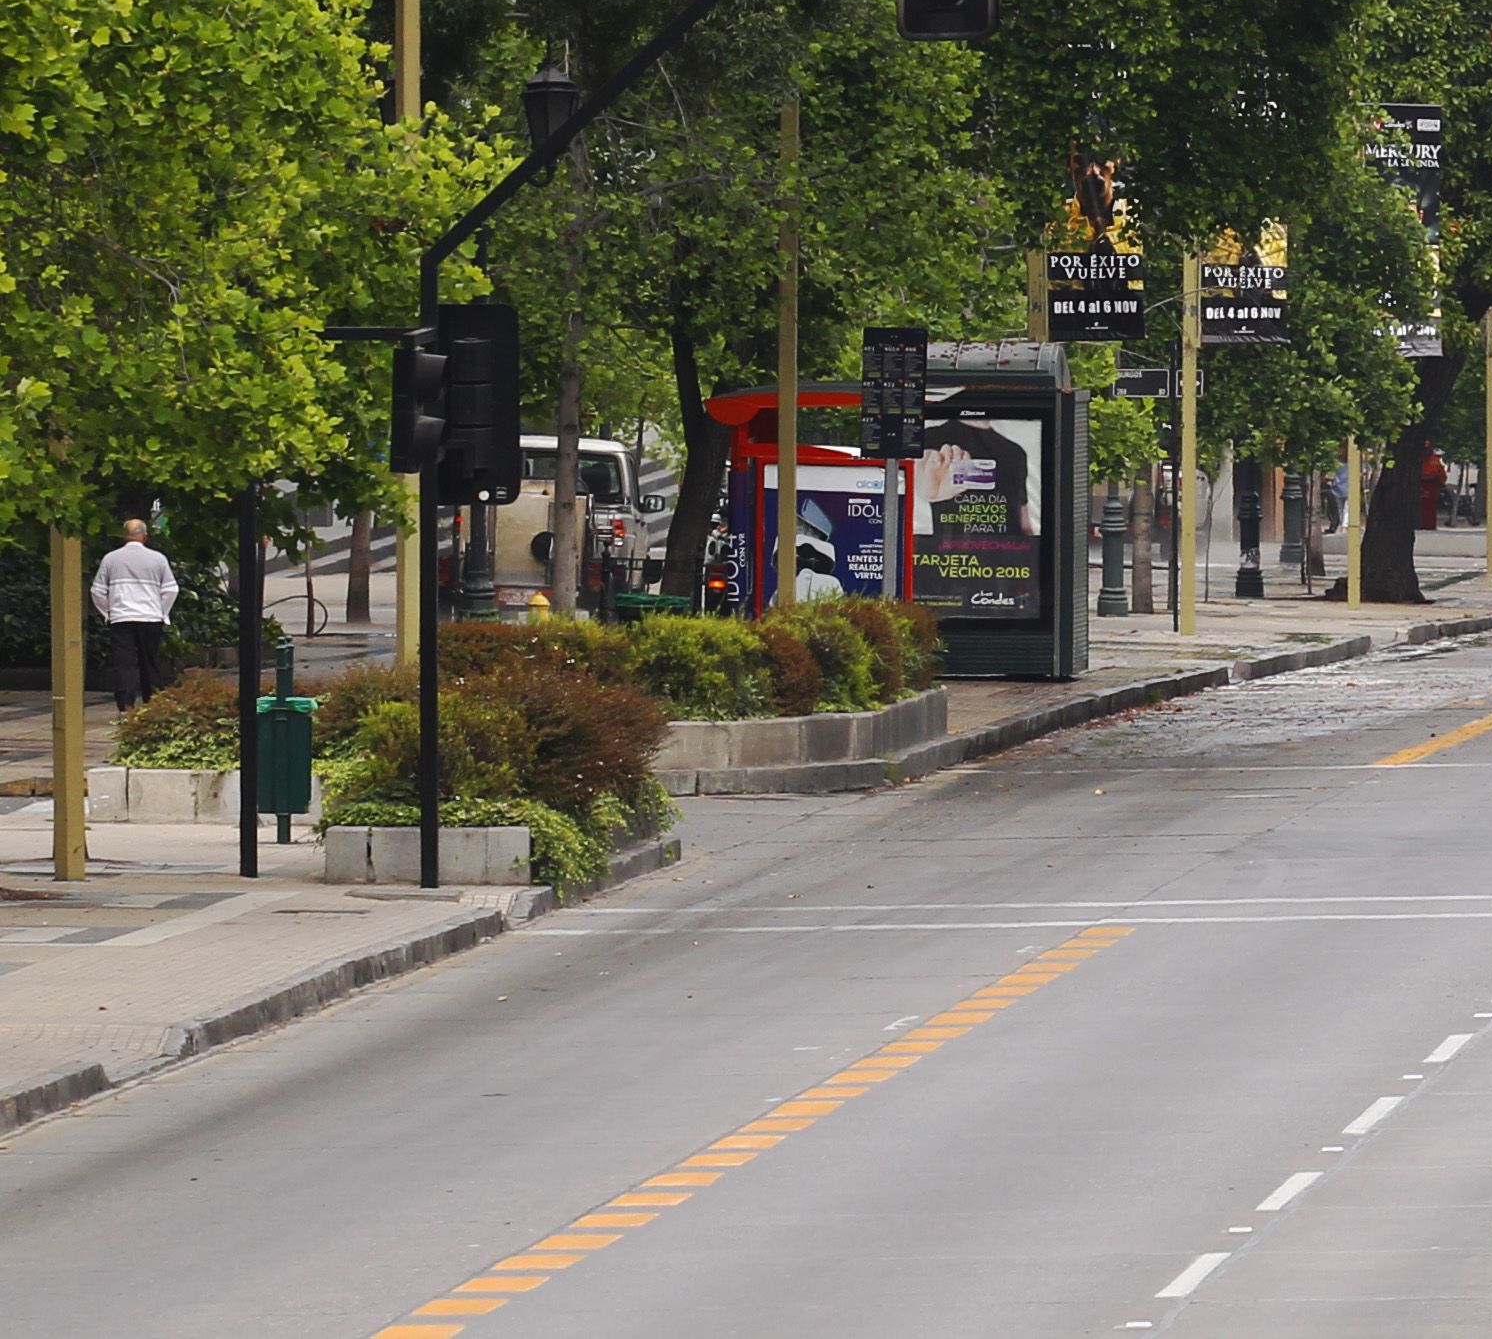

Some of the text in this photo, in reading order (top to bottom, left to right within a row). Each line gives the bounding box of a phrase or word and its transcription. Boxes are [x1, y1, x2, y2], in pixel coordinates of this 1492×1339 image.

[1050, 254, 1140, 268] POR ÉXITO
[1065, 267, 1126, 279] VUELVE
[1204, 265, 1285, 279] POR ÉXITO
[1217, 278, 1272, 289] VUELVE
[1054, 300, 1138, 314] DEL 4 al 6 NOV
[1206, 306, 1281, 320] DEL 4 al 6 NOV
[955, 493, 1008, 504] CADA DÍA
[847, 504, 884, 517] IDOL
[959, 504, 1007, 514] NUEVOS
[940, 513, 1007, 523] BENEFICIOS
[963, 524, 1007, 533] PARA TI
[739, 533, 746, 547] VR
[847, 554, 878, 563] LENTES
[912, 554, 980, 566] TARJETA
[848, 563, 883, 571] REALIDA
[938, 566, 1031, 579] VECINO 2016
[970, 592, 1016, 606] Condes
